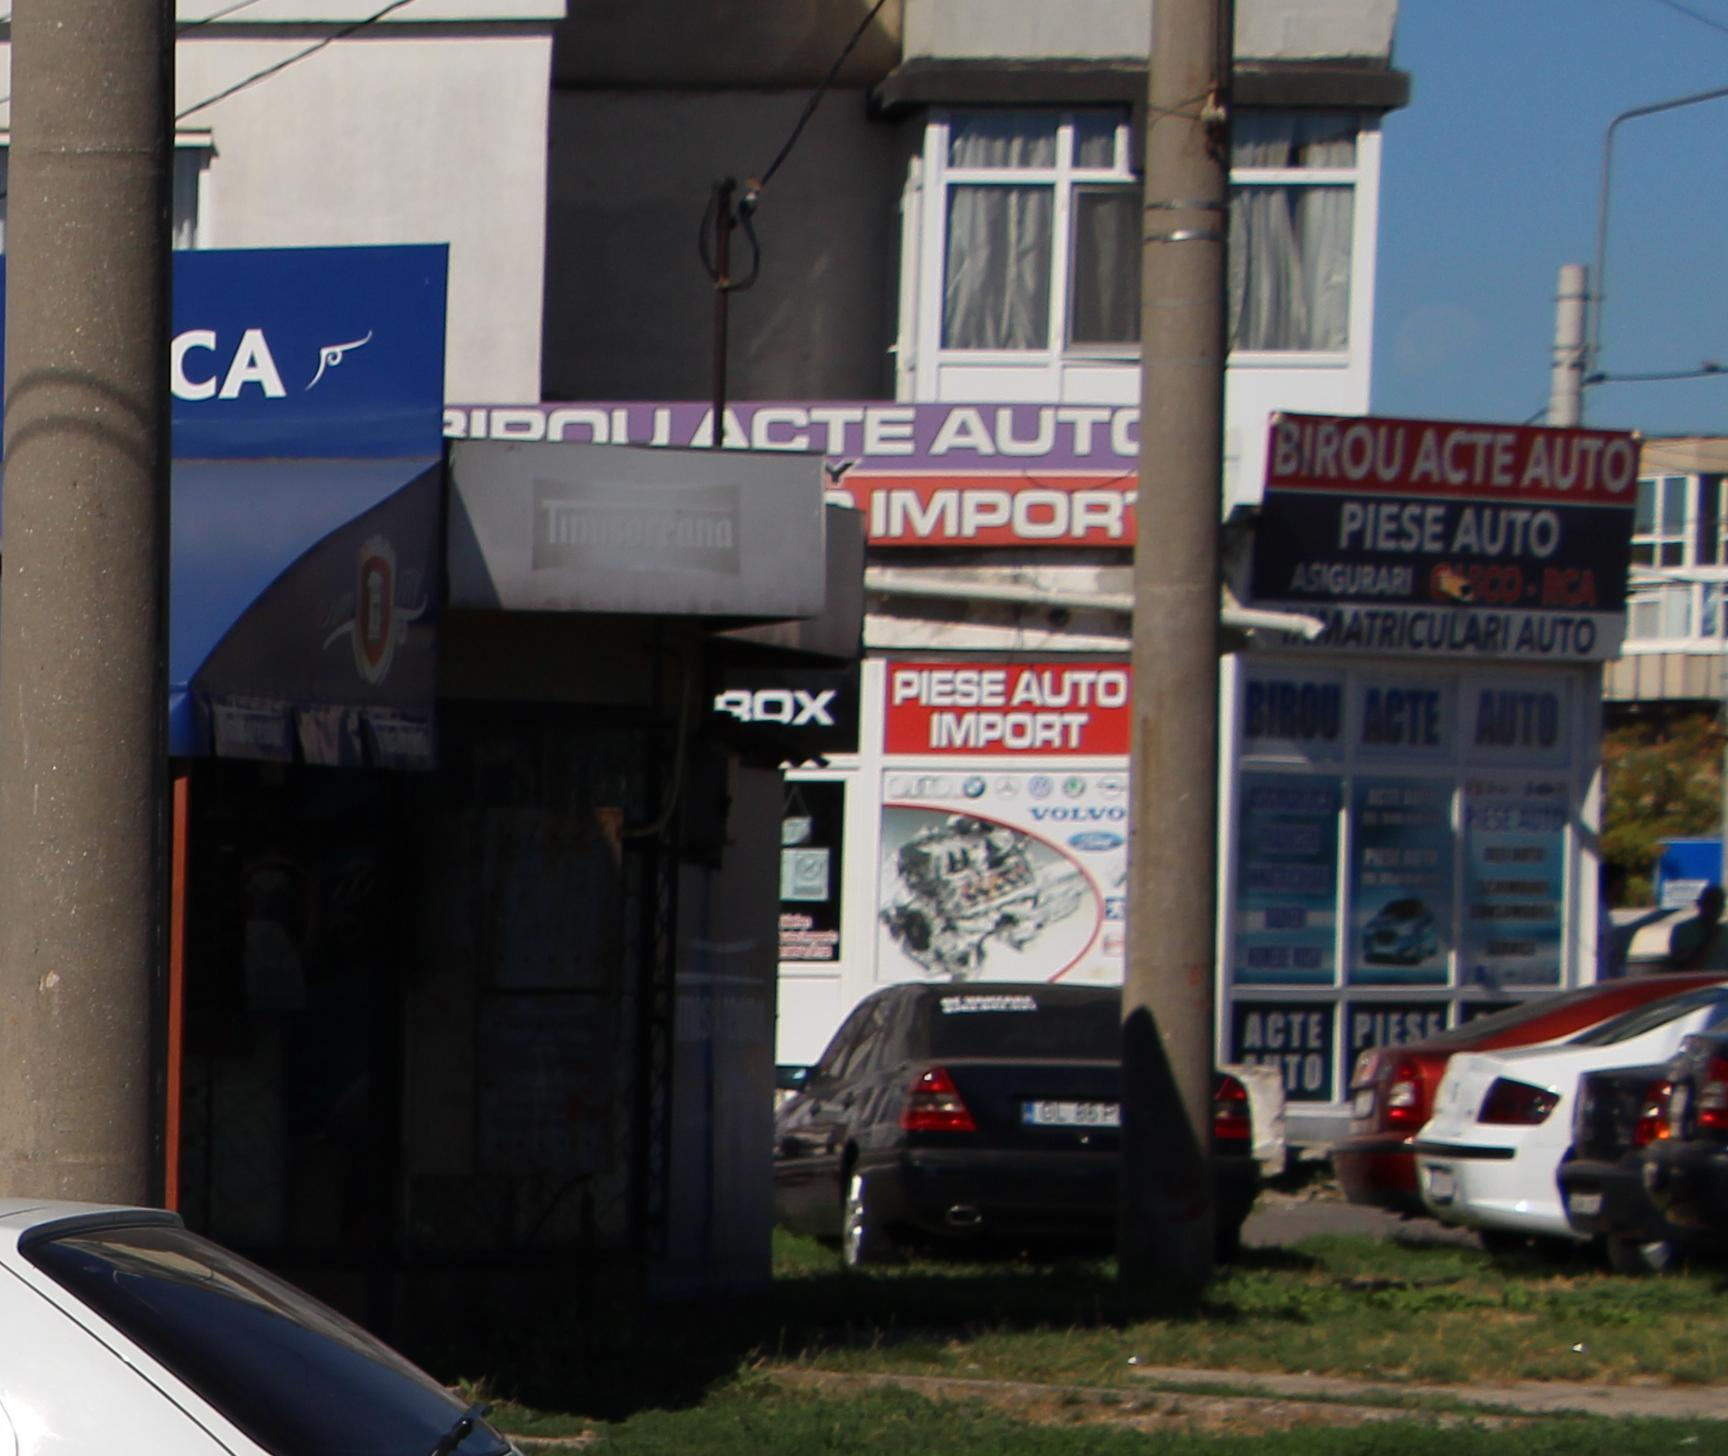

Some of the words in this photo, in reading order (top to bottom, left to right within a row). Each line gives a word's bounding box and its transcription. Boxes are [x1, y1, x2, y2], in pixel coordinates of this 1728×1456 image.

[1272, 422, 1406, 482] BIROU
[1409, 427, 1517, 487] ACTE
[1519, 432, 1635, 494] AUTO
[870, 488, 1139, 538] IMPOR
[1338, 502, 1444, 553] PIESE
[1449, 506, 1561, 558] AUTO
[1288, 562, 1413, 597] ASIGURARI
[1514, 615, 1597, 655] AUTO
[892, 670, 1007, 707] PIESE
[1010, 671, 1128, 707] AUTO
[928, 713, 1090, 750] IMPORT
[1245, 679, 1342, 740] BIROU
[1361, 686, 1441, 746] ACTE
[1473, 688, 1560, 747] AUTO
[1029, 806, 1126, 821] VOLVO
[1244, 1011, 1323, 1049] ACTE
